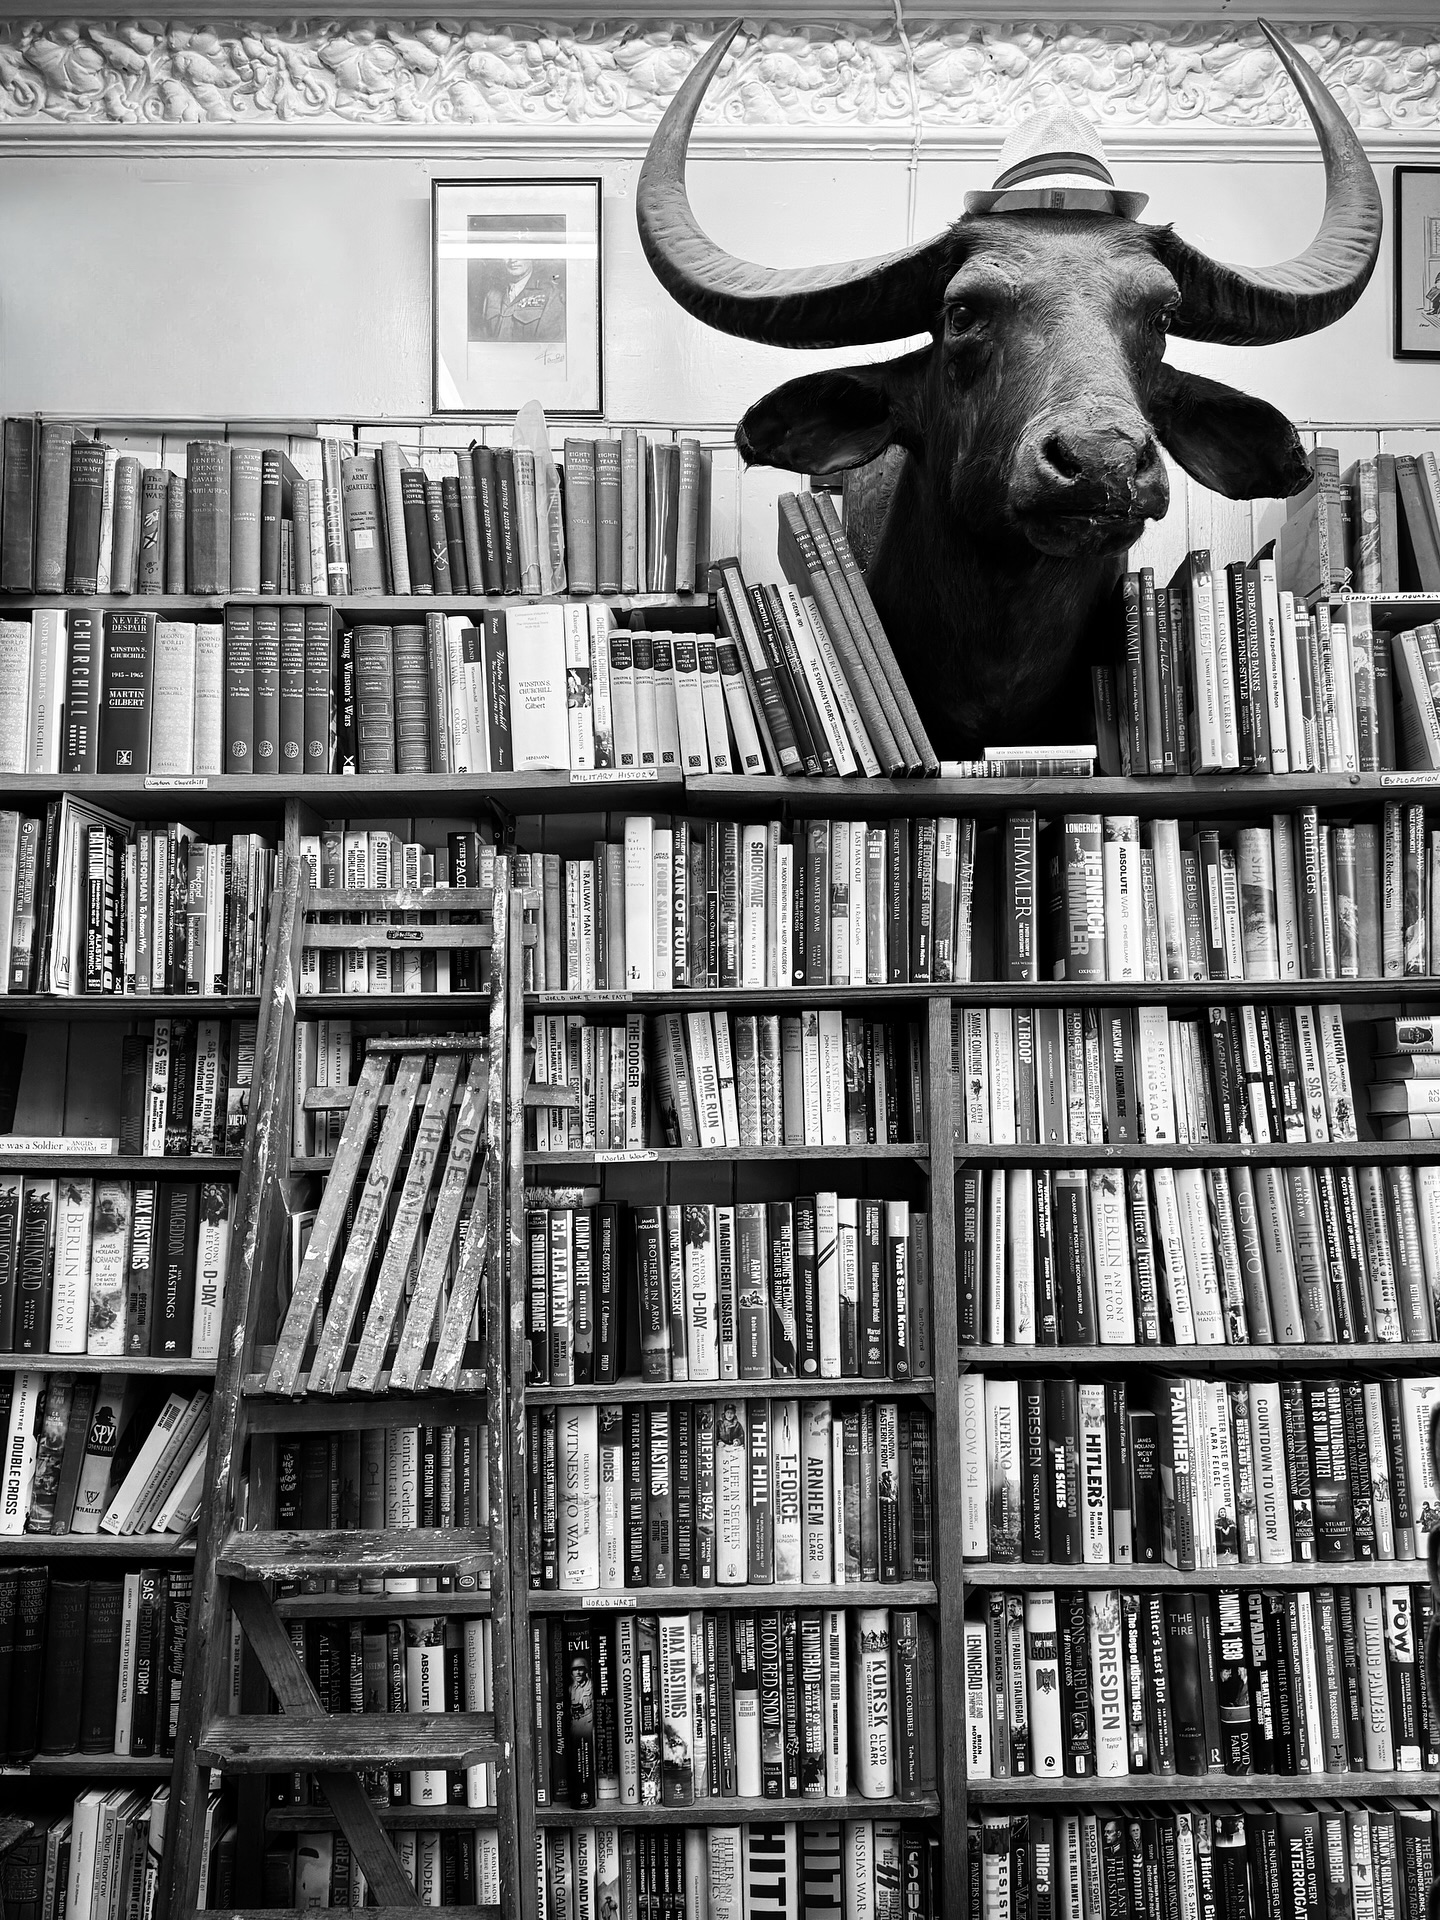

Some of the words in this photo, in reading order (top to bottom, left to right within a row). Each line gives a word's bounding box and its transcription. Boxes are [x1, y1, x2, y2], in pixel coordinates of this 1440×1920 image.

[481, 477, 489, 508] FUSILIERS
[112, 616, 147, 625] NEVER
[1217, 600, 1225, 618] THE
[1235, 573, 1245, 626] HIMALAYA
[1247, 581, 1259, 658] ENDEAVOURING
[112, 623, 147, 632] DESPAIR
[340, 629, 352, 659] Young
[808, 603, 826, 641] WINSTON
[823, 643, 844, 688] CHURCHILL
[1126, 605, 1140, 663] SUMMIT
[1199, 595, 1212, 655] EVEREST
[71, 619, 91, 716] CHURCHILL
[1219, 622, 1228, 673] CONQUEST
[109, 690, 144, 698] MARTIN
[343, 662, 352, 704] Winston's
[1222, 678, 1230, 691] OF
[1251, 660, 1261, 691] BANKS
[109, 698, 144, 706] GILBERT
[344, 707, 352, 727] Wars
[1223, 694, 1232, 736] EVEREST
[572, 772, 613, 780] MILITARY
[618, 771, 654, 779] HISTORY
[1384, 776, 1438, 784] EXPLORATION
[1066, 823, 1102, 834] LONGERICH
[90, 830, 104, 880] BATTALION
[675, 853, 686, 895] RAIN
[751, 841, 763, 908] SHOCKWAVE
[1015, 827, 1032, 919] HIMMLER
[1119, 847, 1127, 894] ABSOLUTE
[1303, 814, 1316, 894] Pathfinders
[1086, 851, 1104, 939] HEINRICH
[1141, 858, 1153, 909] EREBUS
[583, 915, 591, 936] MAN
[675, 900, 686, 924] OF
[1120, 896, 1128, 918] WAR
[675, 928, 686, 968] RUIN
[629, 1019, 639, 1041] THE
[1018, 1015, 1029, 1025] X
[156, 1028, 168, 1057] SAS
[207, 1041, 216, 1058] SAS
[1018, 1025, 1031, 1064] TROOP
[206, 1062, 216, 1094] STORM
[629, 1043, 639, 1088] DODGER
[702, 1065, 716, 1099] HOME
[204, 1098, 213, 1128] FRONT
[707, 1103, 719, 1129] RUN
[32, 1140, 63, 1150] Soldier
[445, 1128, 476, 1187] USE
[137, 1189, 153, 1215] MAX
[719, 1214, 729, 1222] A
[65, 1213, 83, 1277] BERLIN
[132, 1217, 152, 1270] HASTINGS
[551, 1218, 567, 1240] EL
[1238, 1191, 1262, 1274] GESTAPO
[22, 1219, 47, 1291] STALINGRAD
[532, 1234, 545, 1276] SOLDIER
[648, 1238, 658, 1286] BROTHERS
[719, 1225, 731, 1290] MAGNIFICENT
[894, 1242, 905, 1273] What
[201, 1270, 217, 1308] D-DAY
[532, 1279, 545, 1292] OF
[551, 1245, 567, 1328] ALAMEIN
[650, 1289, 658, 1300] IN
[896, 1276, 905, 1309] Stalin
[56, 1284, 65, 1330] BEEVOR
[66, 1282, 75, 1332] ANTONY
[532, 1294, 545, 1332] ORANGE
[651, 1303, 660, 1331] ARMS
[720, 1293, 733, 1342] DISASTER
[897, 1313, 906, 1348] Knew
[91, 1425, 115, 1444] SPY
[650, 1412, 668, 1440] MAX
[752, 1422, 767, 1459] THE
[963, 1383, 976, 1456] MOSCOW
[999, 1406, 1011, 1469] INFERNO
[1028, 1395, 1042, 1467] DRESDEN
[1169, 1387, 1188, 1474] PANTHER
[1256, 1399, 1272, 1471] COUNTDOWN
[10, 1436, 24, 1476] DOUBLE
[566, 1418, 579, 1488] WITNESS
[650, 1441, 668, 1496] HASTINGS
[701, 1432, 713, 1477] DIEPPE
[1085, 1434, 1104, 1508] HITLER'S
[752, 1465, 767, 1507] HILL
[780, 1454, 797, 1524] T-FORCE
[808, 1457, 824, 1526] ARNHEM
[968, 1460, 978, 1490] 1941
[1262, 1471, 1273, 1487] TO
[6, 1478, 20, 1515] CROSS
[566, 1493, 579, 1514] TO
[703, 1490, 715, 1521] 1942
[1265, 1489, 1277, 1542] VICTORY
[566, 1518, 579, 1564] WAR
[142, 1579, 155, 1600] SAS
[1169, 1614, 1193, 1624] THE
[1170, 1625, 1194, 1636] FIRE
[1248, 1593, 1265, 1668] CITADEL
[1392, 1599, 1409, 1654] POW
[568, 1641, 590, 1650] EVIL
[621, 1620, 631, 1668] HITLER'S
[801, 1620, 820, 1682] LENINGRAD
[1223, 1632, 1244, 1661] 1938
[1362, 1615, 1379, 1666] VIKING
[137, 1659, 150, 1695] STORM
[872, 1659, 889, 1728] KURSK
[1098, 1633, 1120, 1730] DRESDEN
[622, 1669, 633, 1745] COMMANDERS
[1368, 1671, 1385, 1734] PANZERS
[855, 1826, 865, 1879] RUSSIA'S
[1304, 1826, 1316, 1870] RICHARD
[1326, 1819, 1345, 1883] NUREMBERG
[857, 1882, 865, 1912] WAR
[1307, 1873, 1318, 1905] OVERY
